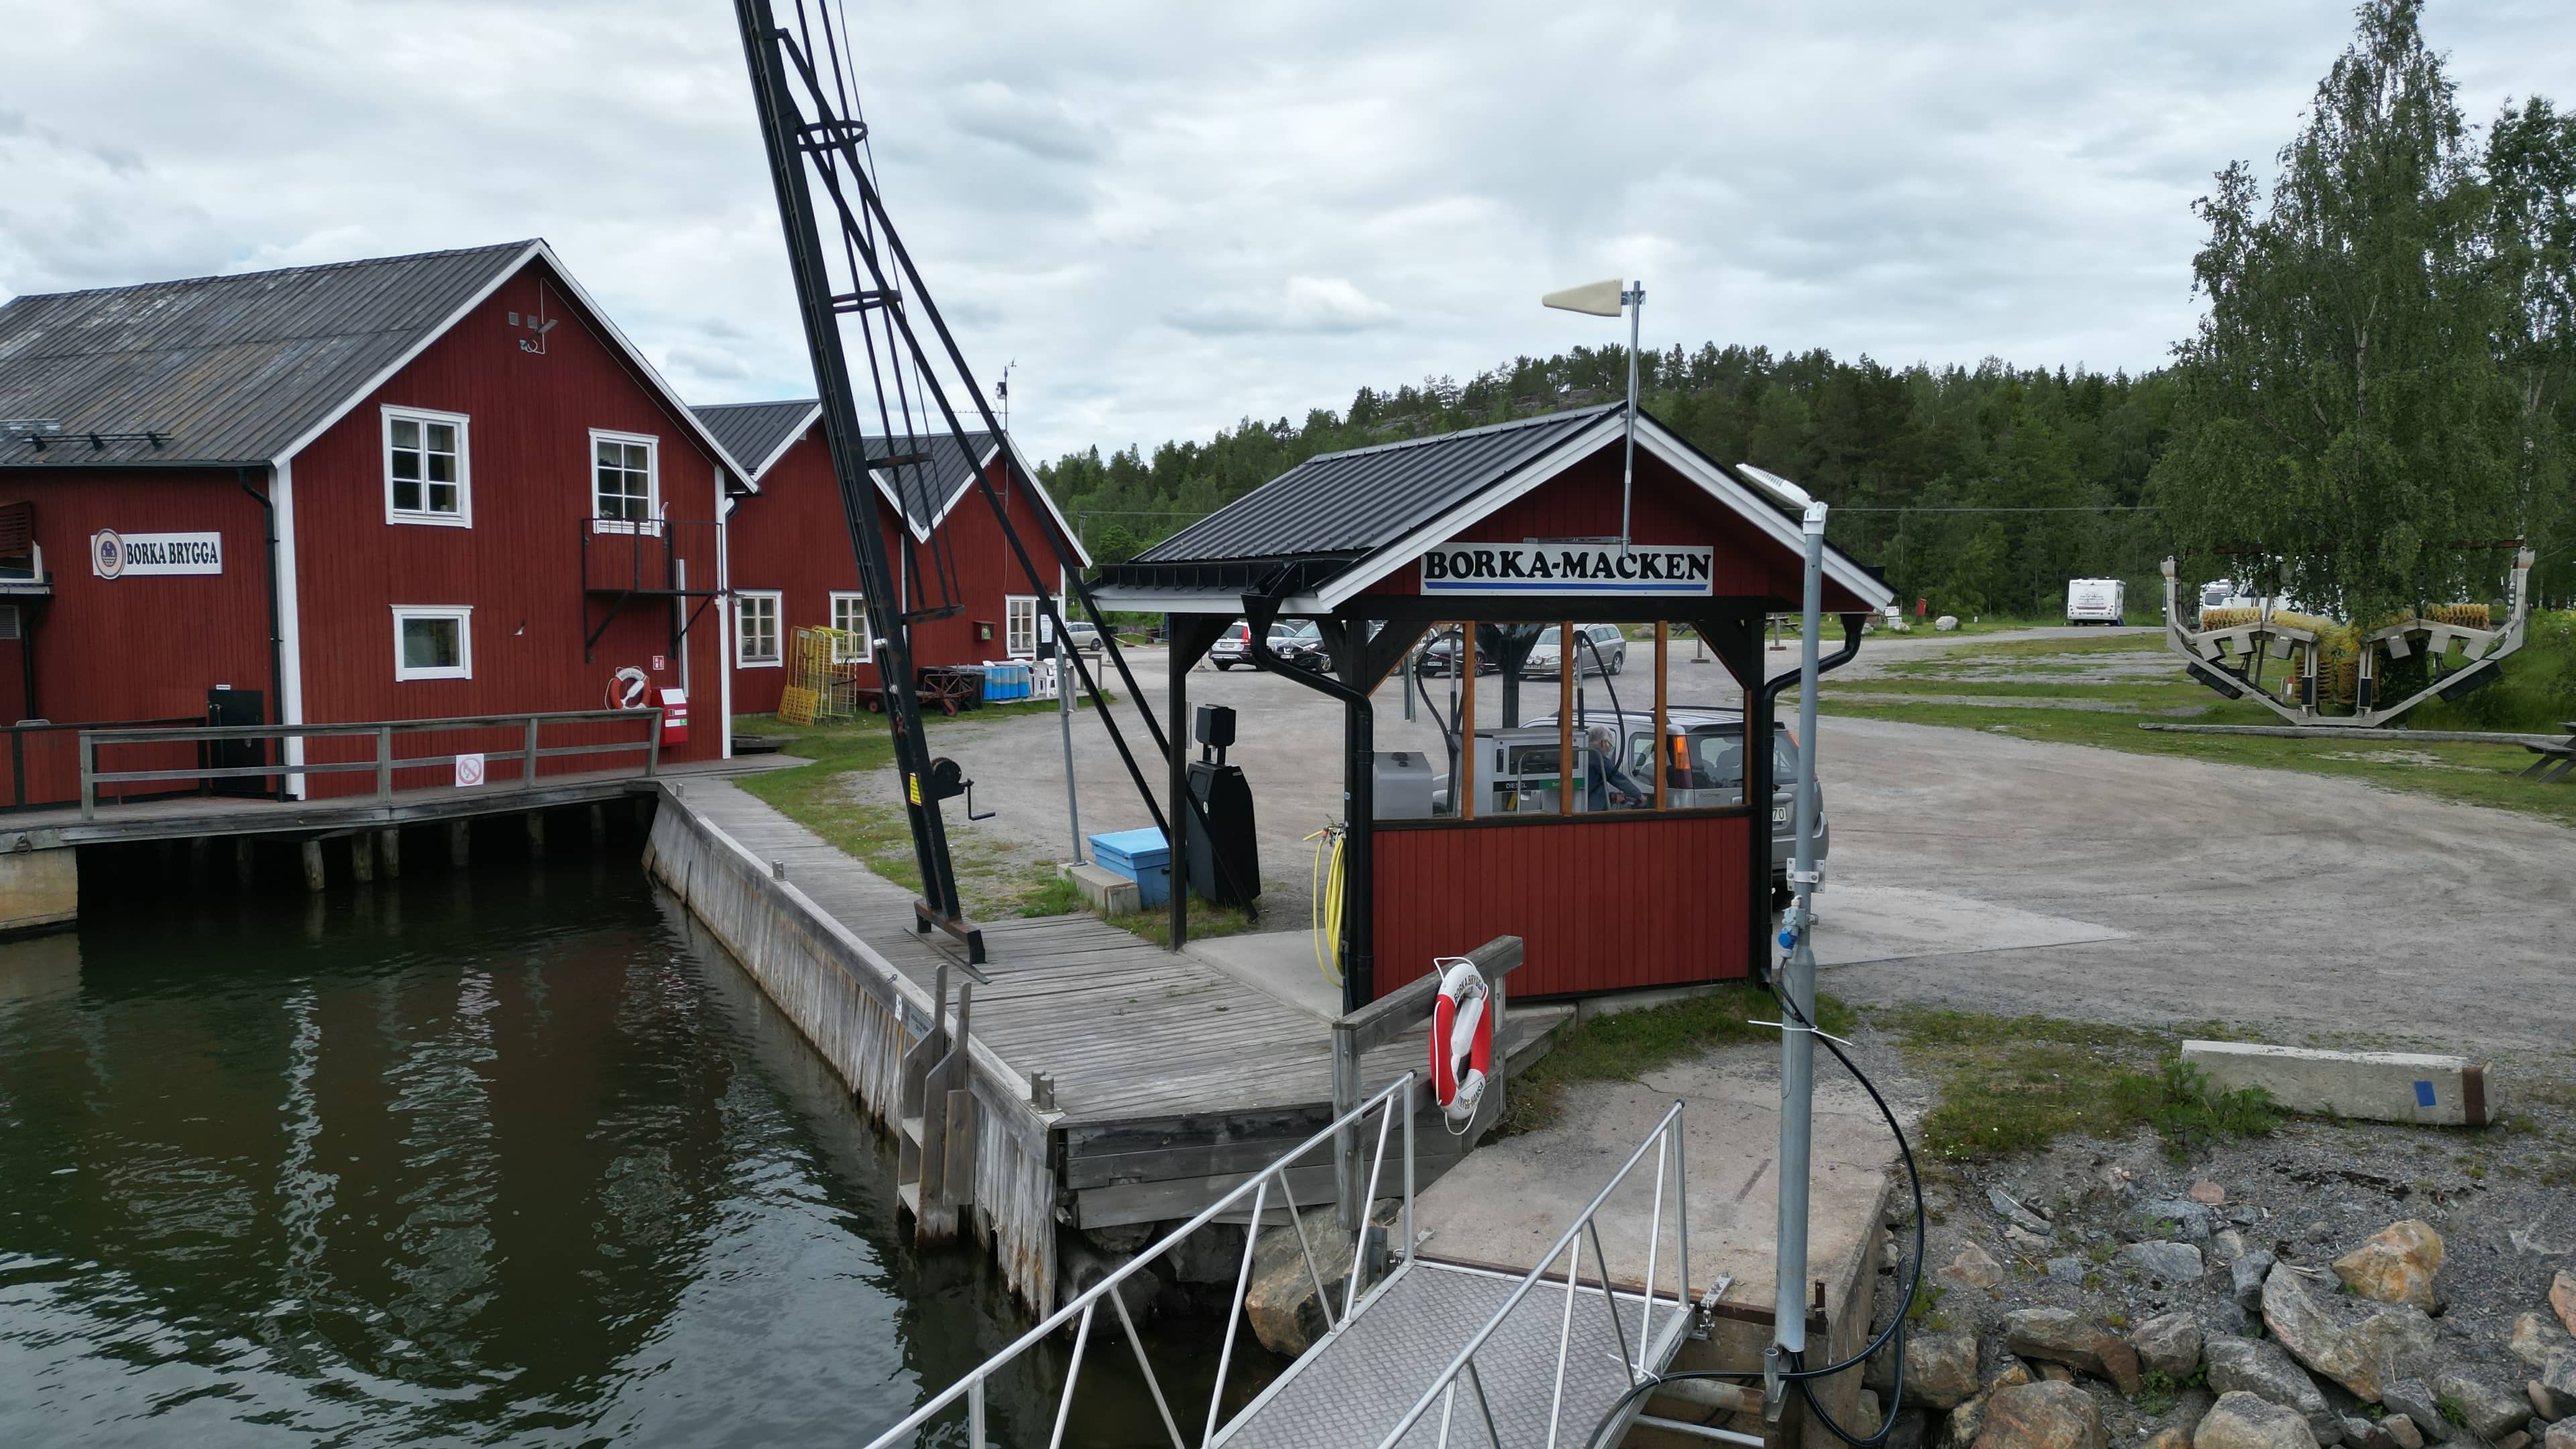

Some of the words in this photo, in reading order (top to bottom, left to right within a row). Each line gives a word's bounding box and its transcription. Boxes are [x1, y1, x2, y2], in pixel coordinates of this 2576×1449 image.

[126, 543, 166, 564] BORKA
[168, 541, 218, 564] BRYGGA
[1424, 550, 1711, 580] BORKA-MACKEN
